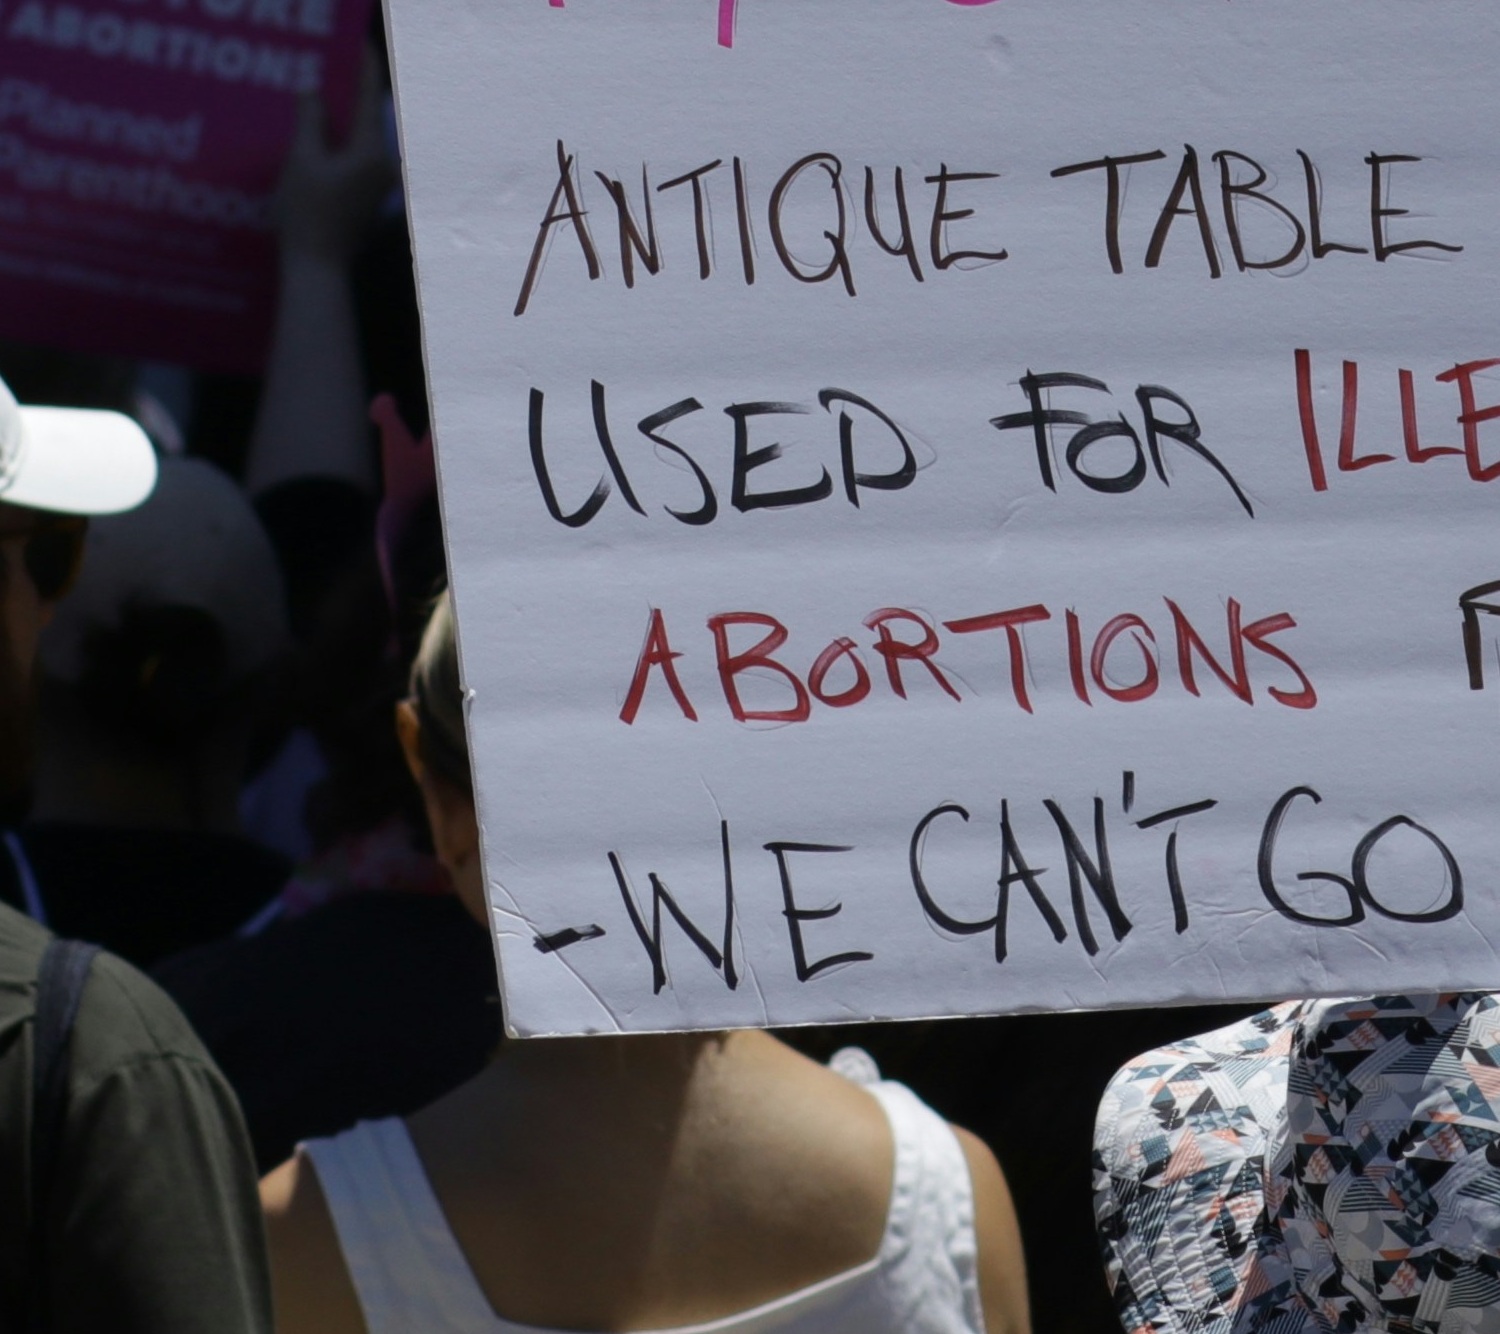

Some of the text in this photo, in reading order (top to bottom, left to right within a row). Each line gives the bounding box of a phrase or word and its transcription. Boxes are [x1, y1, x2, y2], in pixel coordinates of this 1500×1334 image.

[6, 0, 324, 95] ABORTIONS
[514, 138, 1009, 317] ANTIQUE
[1050, 143, 1464, 281] TABLE
[528, 378, 917, 528] USED
[619, 596, 1318, 726] ABORTIONS
[909, 770, 1219, 964] CAN'T
[1257, 785, 1464, 928] GO
